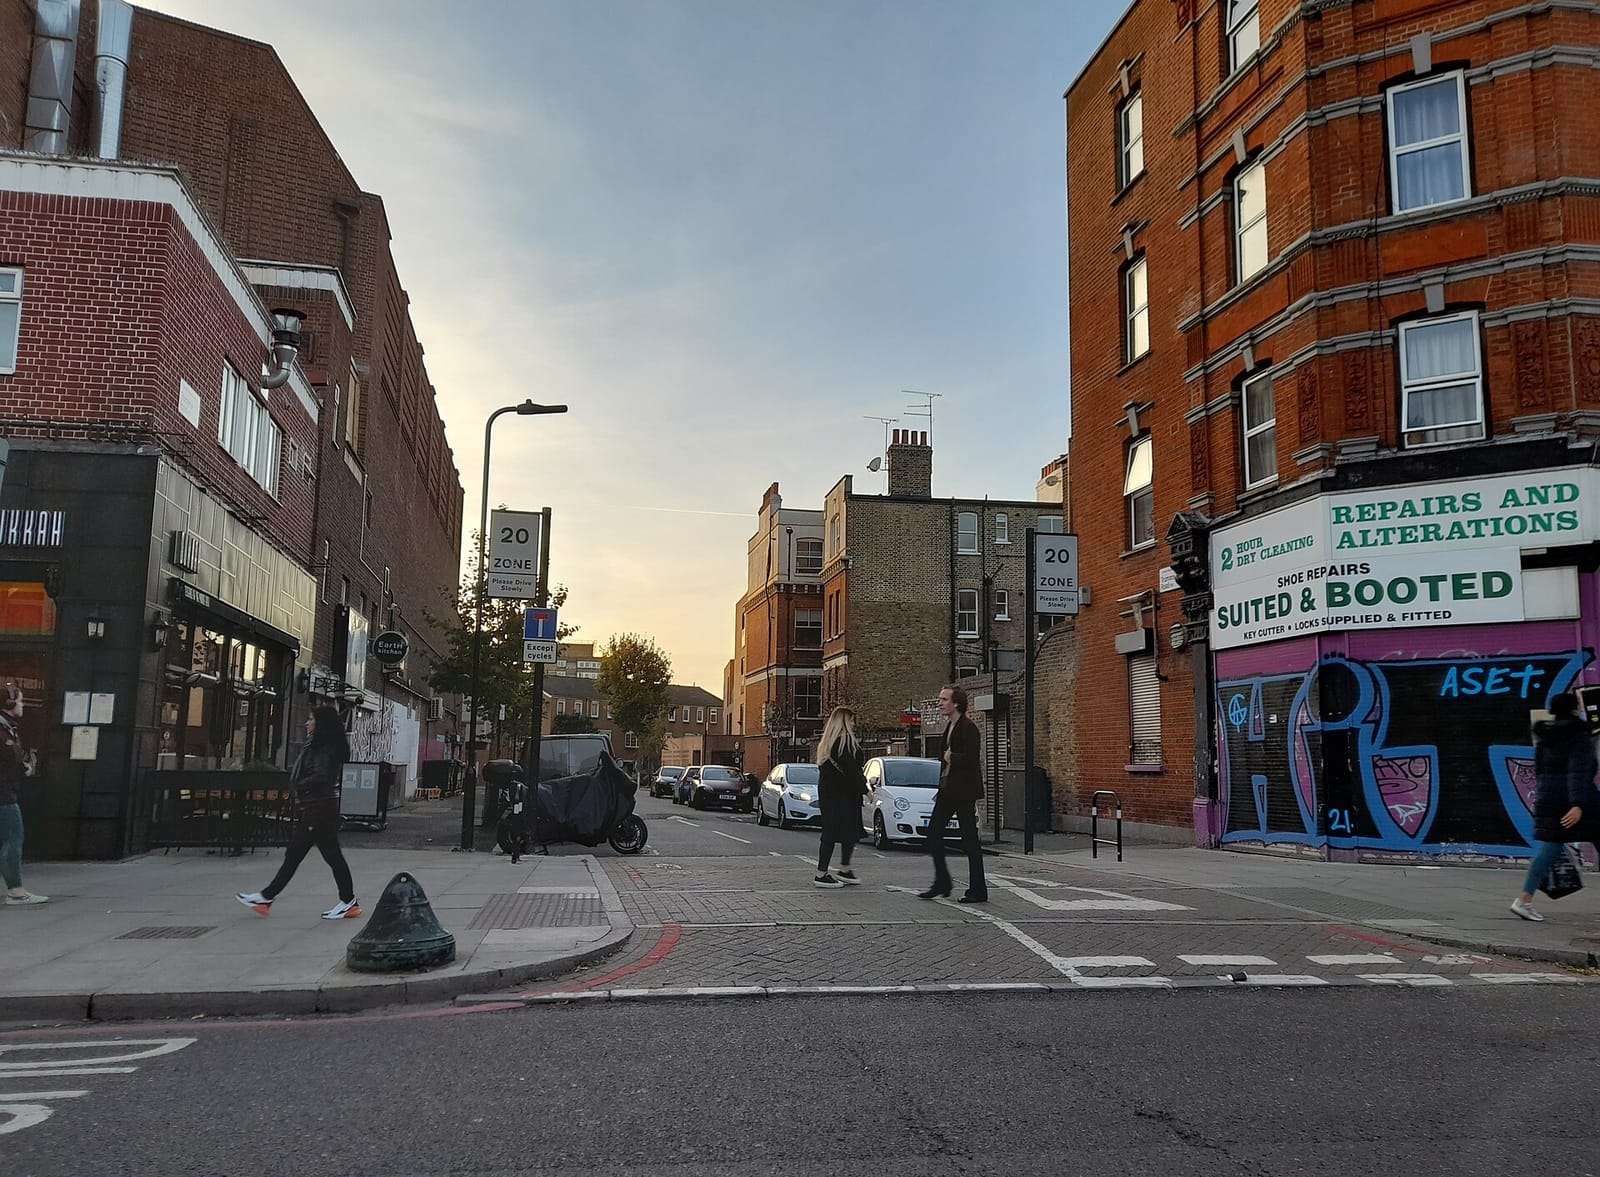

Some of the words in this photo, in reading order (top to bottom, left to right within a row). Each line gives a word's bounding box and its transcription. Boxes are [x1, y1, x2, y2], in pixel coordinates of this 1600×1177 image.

[1332, 493, 1482, 524] REPAIRS
[1499, 482, 1581, 509] AND
[501, 527, 529, 544] 20
[1335, 510, 1580, 550] ALTERATIONS
[1045, 549, 1069, 563] 20
[1221, 547, 1233, 572] 2
[1236, 536, 1263, 554] HOUR
[1236, 551, 1257, 567] DRY
[1260, 534, 1314, 561] CLEANING
[494, 558, 531, 569] ZONE
[492, 577, 513, 585] Please
[1040, 577, 1073, 587] ZONE
[1277, 571, 1304, 588] SHOE
[1306, 562, 1371, 582] REPAIRS
[500, 584, 522, 592] Slowly
[1217, 592, 1292, 629] SUITED
[1299, 586, 1317, 613] &
[1325, 570, 1514, 608] BOOTED
[1243, 629, 1257, 640] KEY
[1257, 624, 1286, 637] CUTTER
[1294, 617, 1320, 631] LOCKS
[1321, 613, 1382, 626] SUPPLIED
[1387, 614, 1397, 622] &
[1402, 609, 1452, 621] FITTED
[527, 643, 554, 652] Except
[527, 652, 552, 660] cycles
